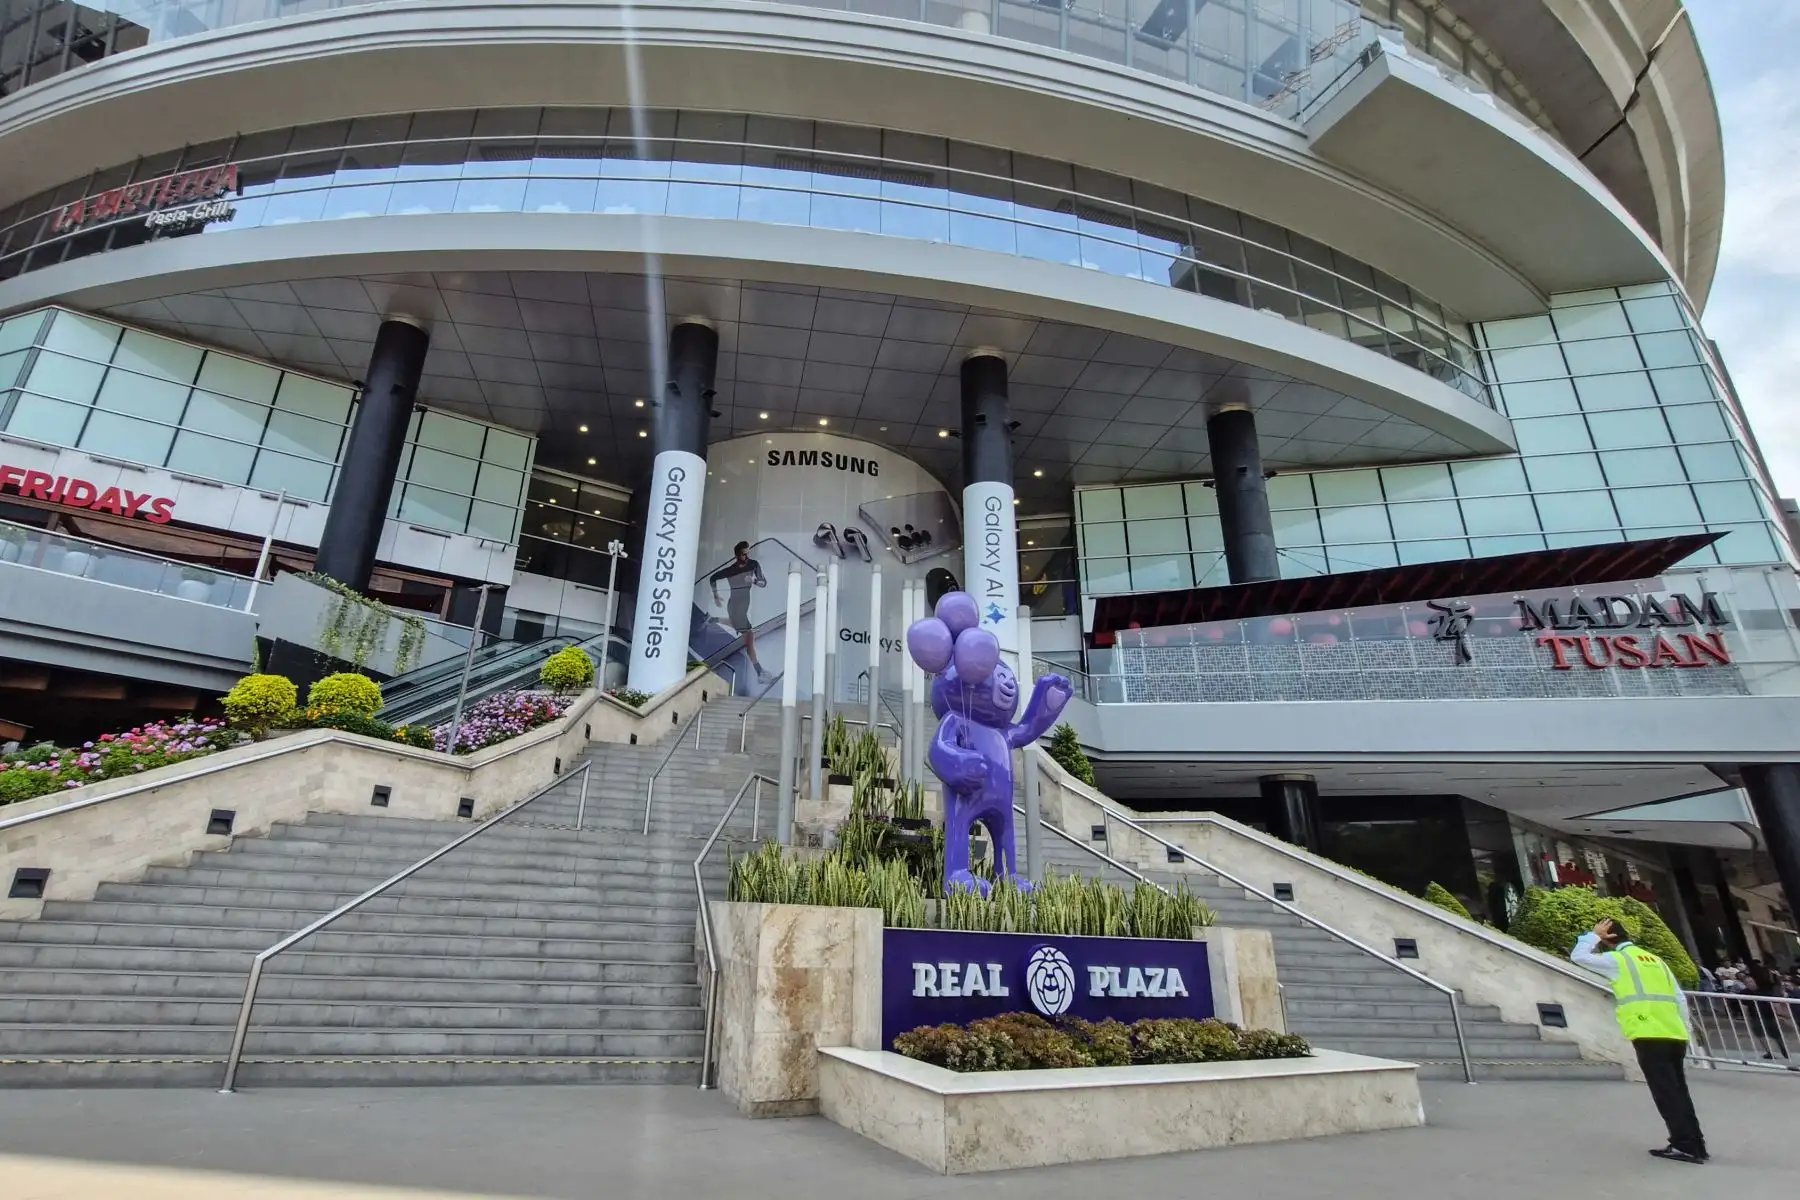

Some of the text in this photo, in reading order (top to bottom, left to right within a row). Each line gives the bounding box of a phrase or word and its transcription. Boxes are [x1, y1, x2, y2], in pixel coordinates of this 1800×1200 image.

[145, 201, 232, 228] Pasta-Grill
[767, 449, 879, 477] SAMSUNG
[0, 465, 176, 524] FRIDAYS
[645, 466, 686, 659] Galaxy S25 Series
[980, 496, 1004, 597] Galaxy AI
[1516, 591, 1730, 631] MADAM
[1536, 632, 1734, 669] TUSAN
[912, 962, 1189, 998] REAL PLAZA
